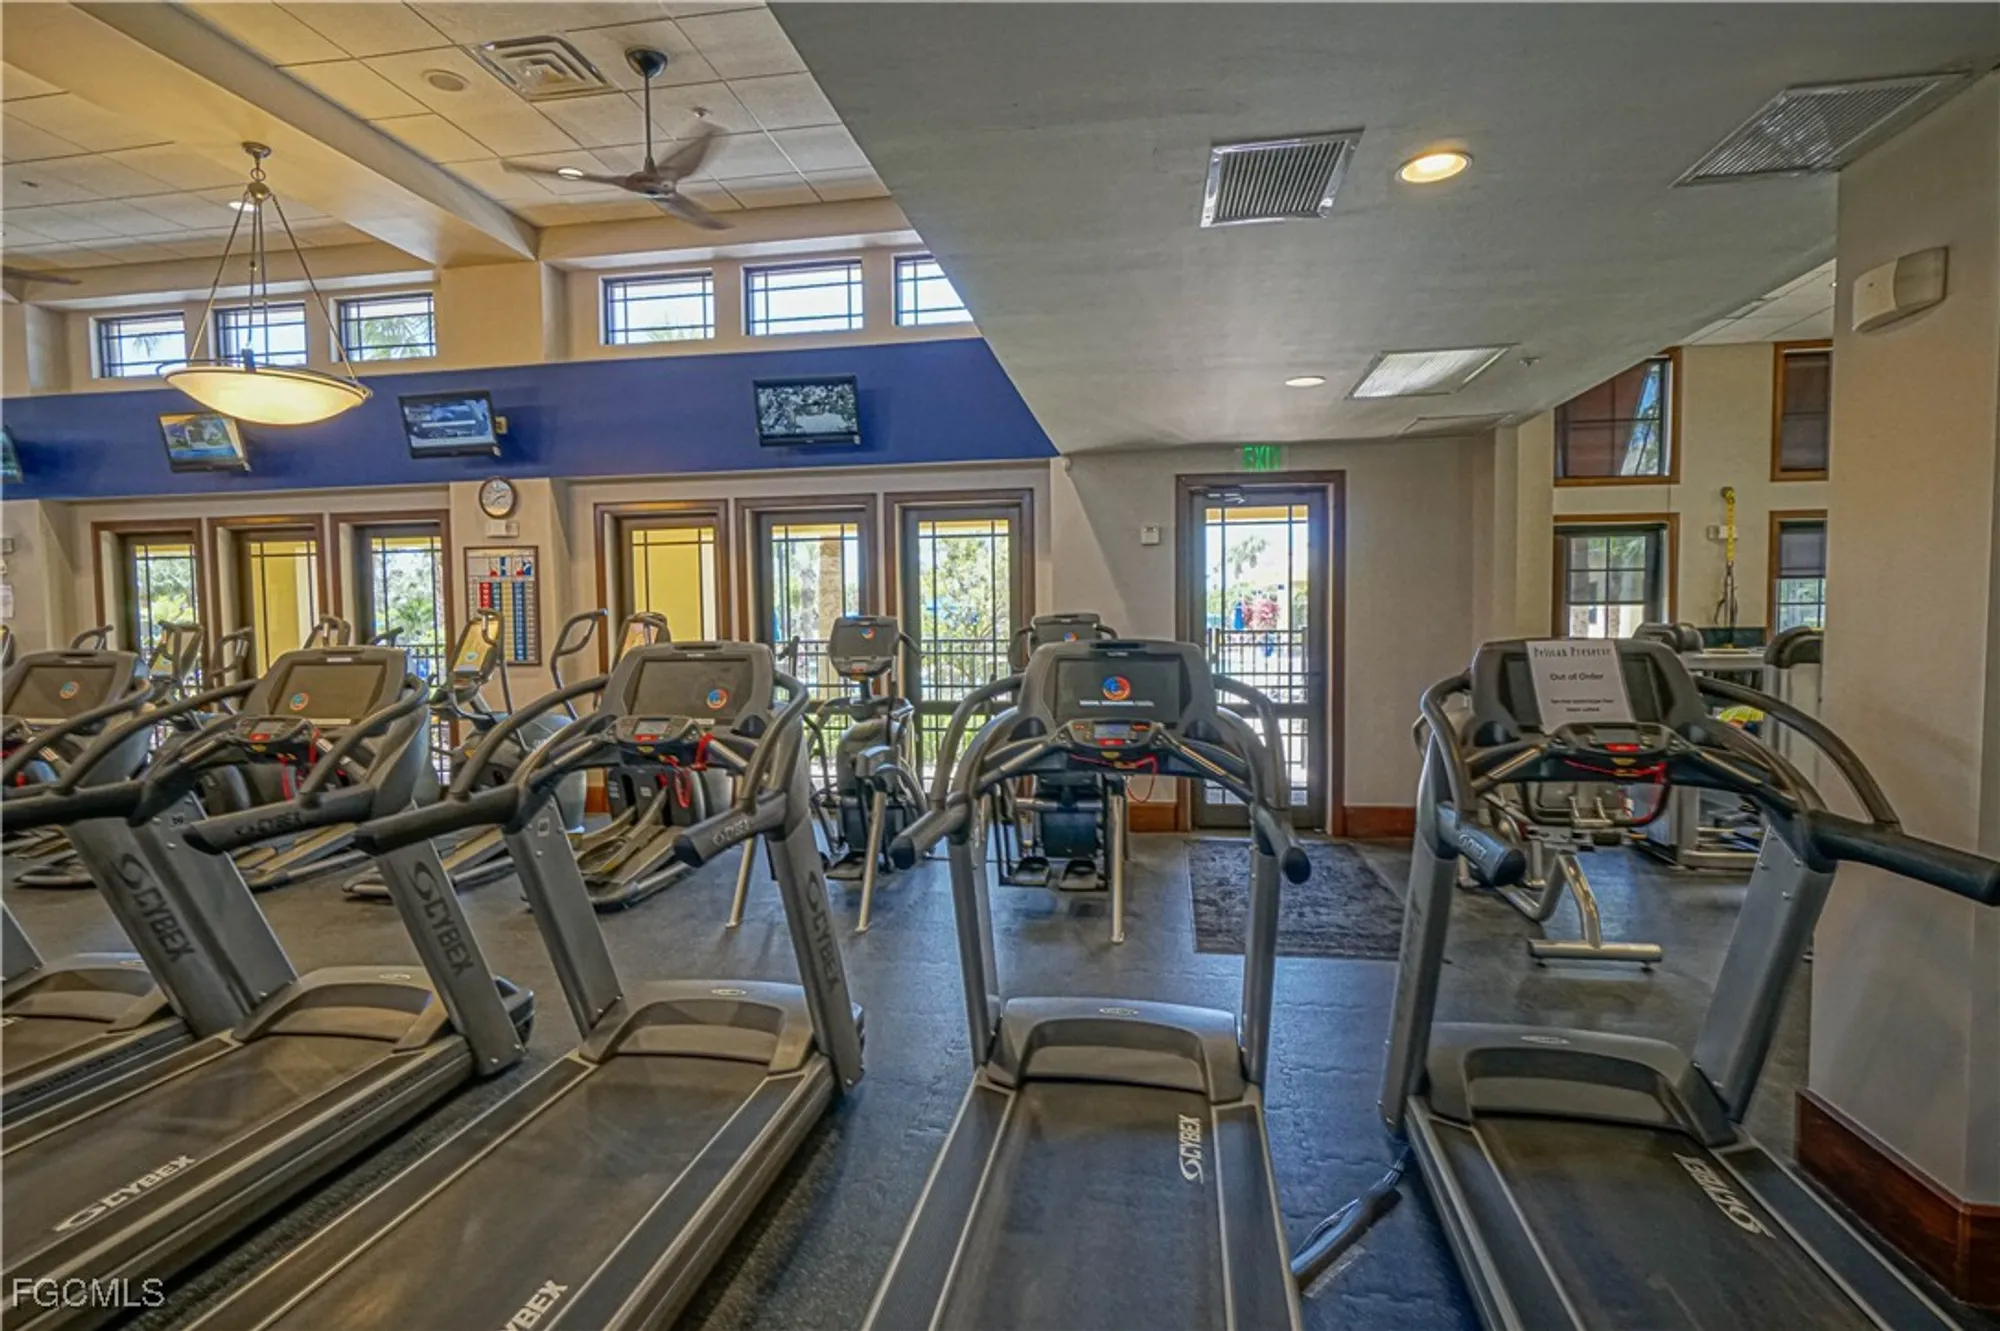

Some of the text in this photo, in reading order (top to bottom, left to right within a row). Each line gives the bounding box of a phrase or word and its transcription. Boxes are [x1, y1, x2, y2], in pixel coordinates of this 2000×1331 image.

[1549, 672, 1604, 681] Out of Order
